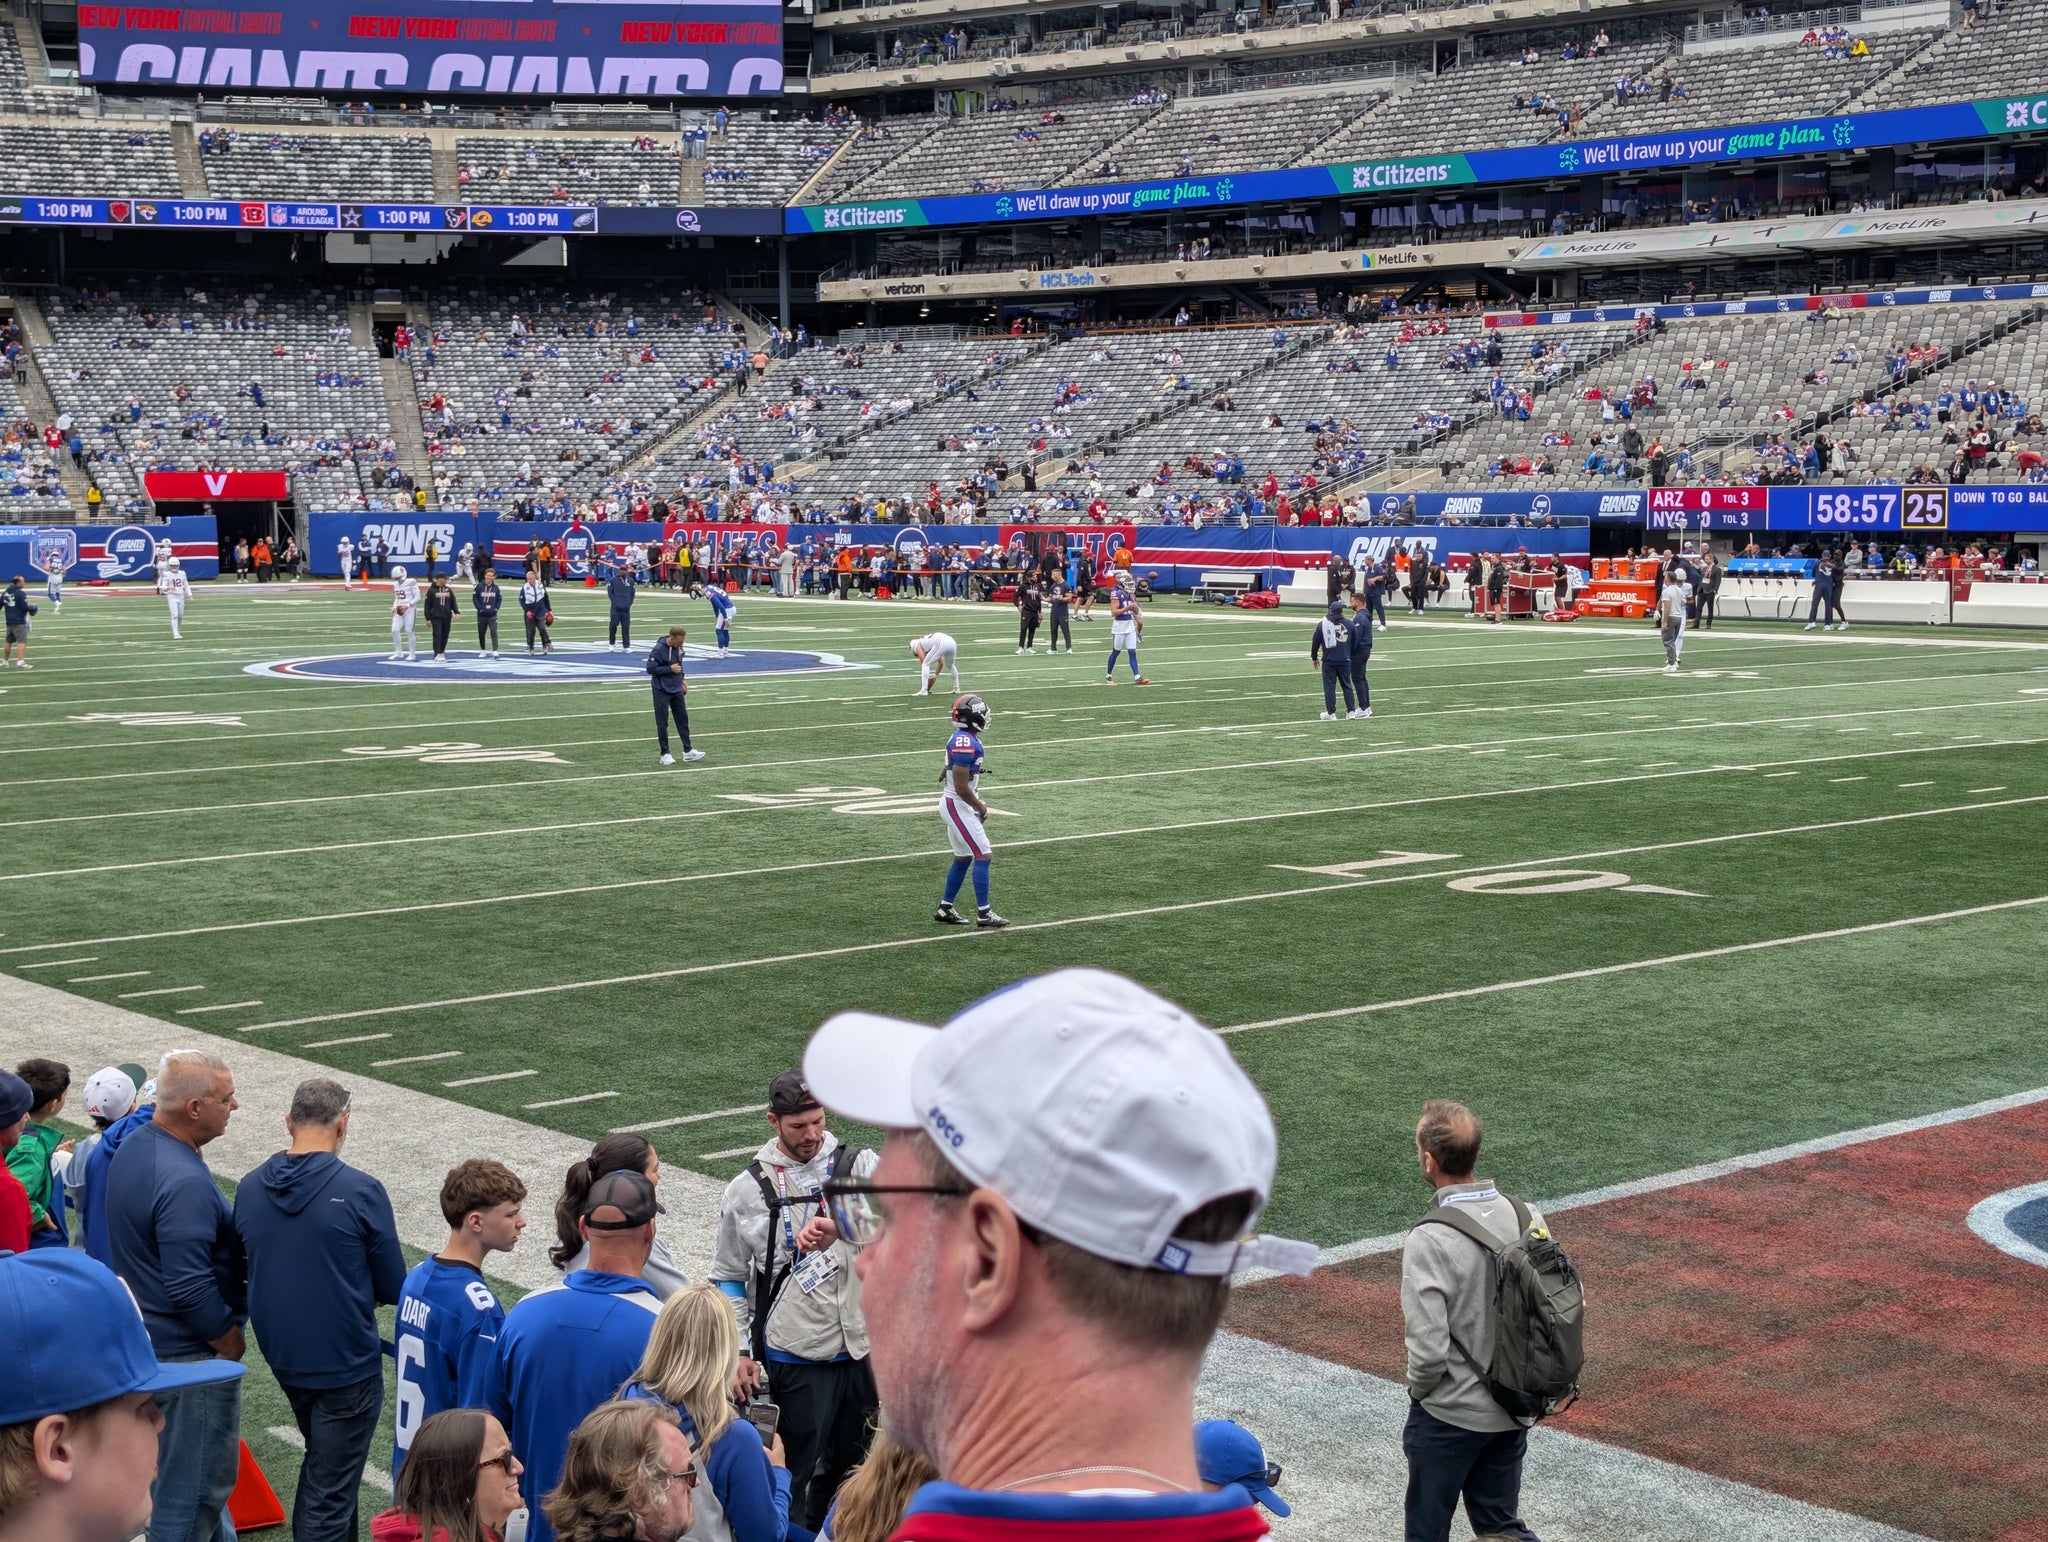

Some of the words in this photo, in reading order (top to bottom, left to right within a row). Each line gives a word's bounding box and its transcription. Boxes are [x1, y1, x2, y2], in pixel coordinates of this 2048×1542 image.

[125, 8, 182, 30] YORK
[182, 10, 236, 34] FOOTBALL
[238, 12, 283, 35] GIANTS
[348, 15, 403, 38] NEW
[404, 18, 459, 39] YORK
[460, 19, 513, 41] FOOTBALL
[515, 20, 557, 42] GIANTS
[620, 21, 674, 44] NEW
[675, 22, 730, 44] YORK
[1623, 141, 1660, 161] draw
[1665, 140, 1685, 159] up
[1688, 137, 1725, 158] your
[1727, 131, 1774, 155] game
[1778, 125, 1825, 150] plan.
[1372, 164, 1448, 187] Citizens
[1049, 192, 1081, 210] draw
[1085, 193, 1099, 210] up
[1101, 191, 1131, 208] your
[1133, 188, 1170, 208] game
[1172, 183, 1211, 204] plan.
[38, 203, 68, 217] 1:00
[71, 204, 93, 218] PM
[173, 206, 206, 220] 1:00
[209, 207, 227, 221] PM
[297, 208, 328, 216] AROUND
[378, 210, 407, 224] 1:00
[410, 211, 431, 225] PM
[840, 207, 904, 227] Citizens
[291, 216, 306, 224] THE
[307, 216, 335, 225] LEAGUE
[507, 211, 538, 226] 1:00
[540, 212, 559, 227] PM
[1866, 218, 1946, 232] MetLife
[1564, 240, 1637, 254] MetLife
[1378, 252, 1418, 266] MetLife
[1040, 271, 1094, 287] HCLTech
[884, 282, 925, 295] verizon
[204, 475, 228, 496] V
[1444, 497, 1483, 514] GIANTS
[1599, 495, 1642, 513] GIANTS
[1653, 491, 1684, 507] ARZ
[1701, 491, 1711, 507] 0
[1723, 495, 1738, 503] TOL
[1741, 492, 1749, 505] 3
[1954, 492, 1985, 503] DOWN
[1992, 492, 2005, 503] TO
[2008, 492, 2022, 503] GO
[1816, 493, 1897, 524] 58:57
[1906, 493, 1943, 524] 25
[1701, 511, 1711, 527] 0
[1722, 515, 1737, 523] TOL
[1740, 512, 1748, 526] 3
[116, 538, 146, 550] GIANTS
[362, 523, 455, 555] GIANTS
[1612, 563, 1618, 572] G
[1635, 563, 1641, 571] G
[1596, 592, 1637, 601] GATORADE
[1578, 603, 1584, 611] G
[1626, 605, 1633, 613] G
[955, 736, 971, 747] 29
[928, 1106, 964, 1147] FOCO
[464, 1281, 496, 1311] 6
[400, 1295, 431, 1332] DART
[396, 1333, 426, 1451] 6
